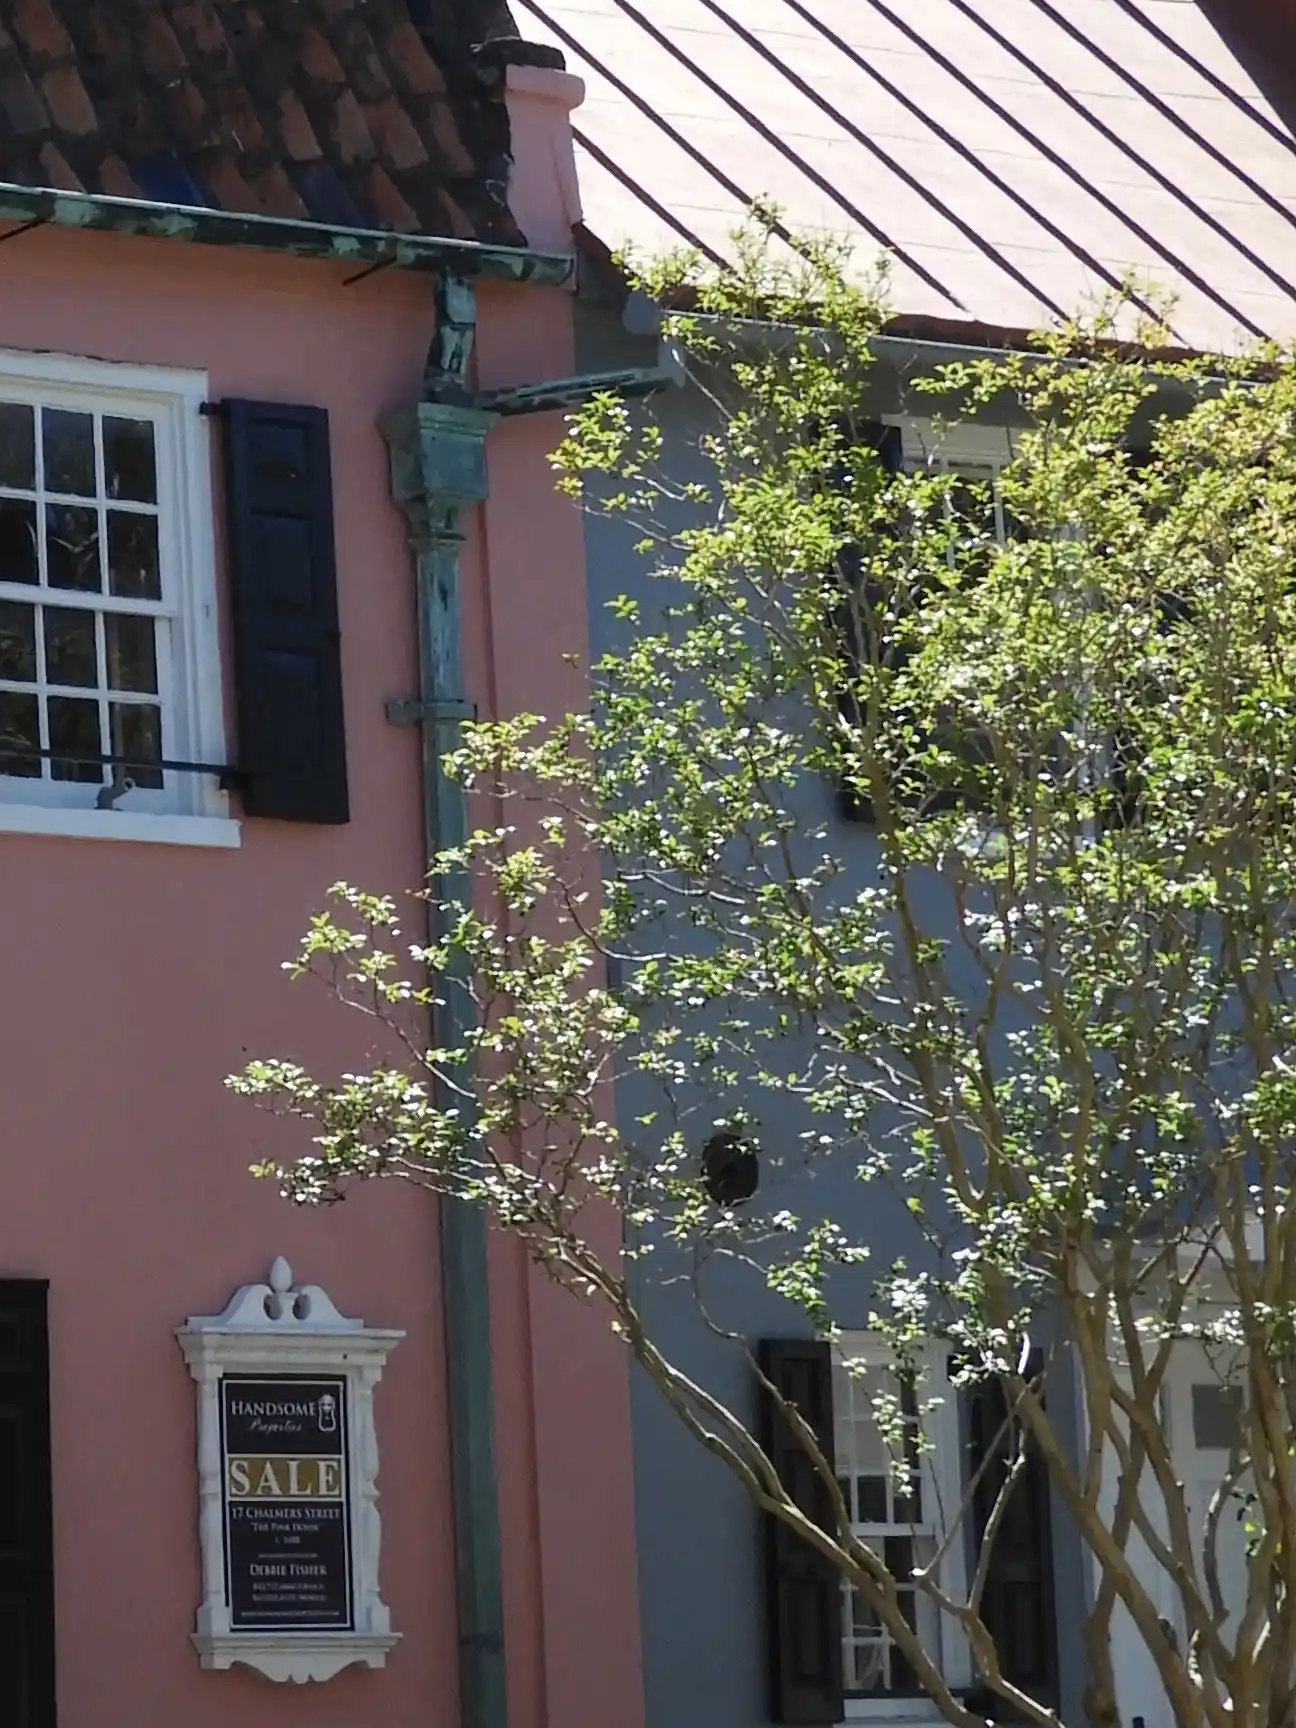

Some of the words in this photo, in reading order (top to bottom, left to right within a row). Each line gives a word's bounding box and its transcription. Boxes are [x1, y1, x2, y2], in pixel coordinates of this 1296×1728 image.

[231, 1400, 316, 1416] HANDSOME
[230, 1459, 340, 1496] SALE
[232, 1507, 244, 1519] 17
[246, 1506, 302, 1520] CHALMERS
[305, 1507, 341, 1520] STREET
